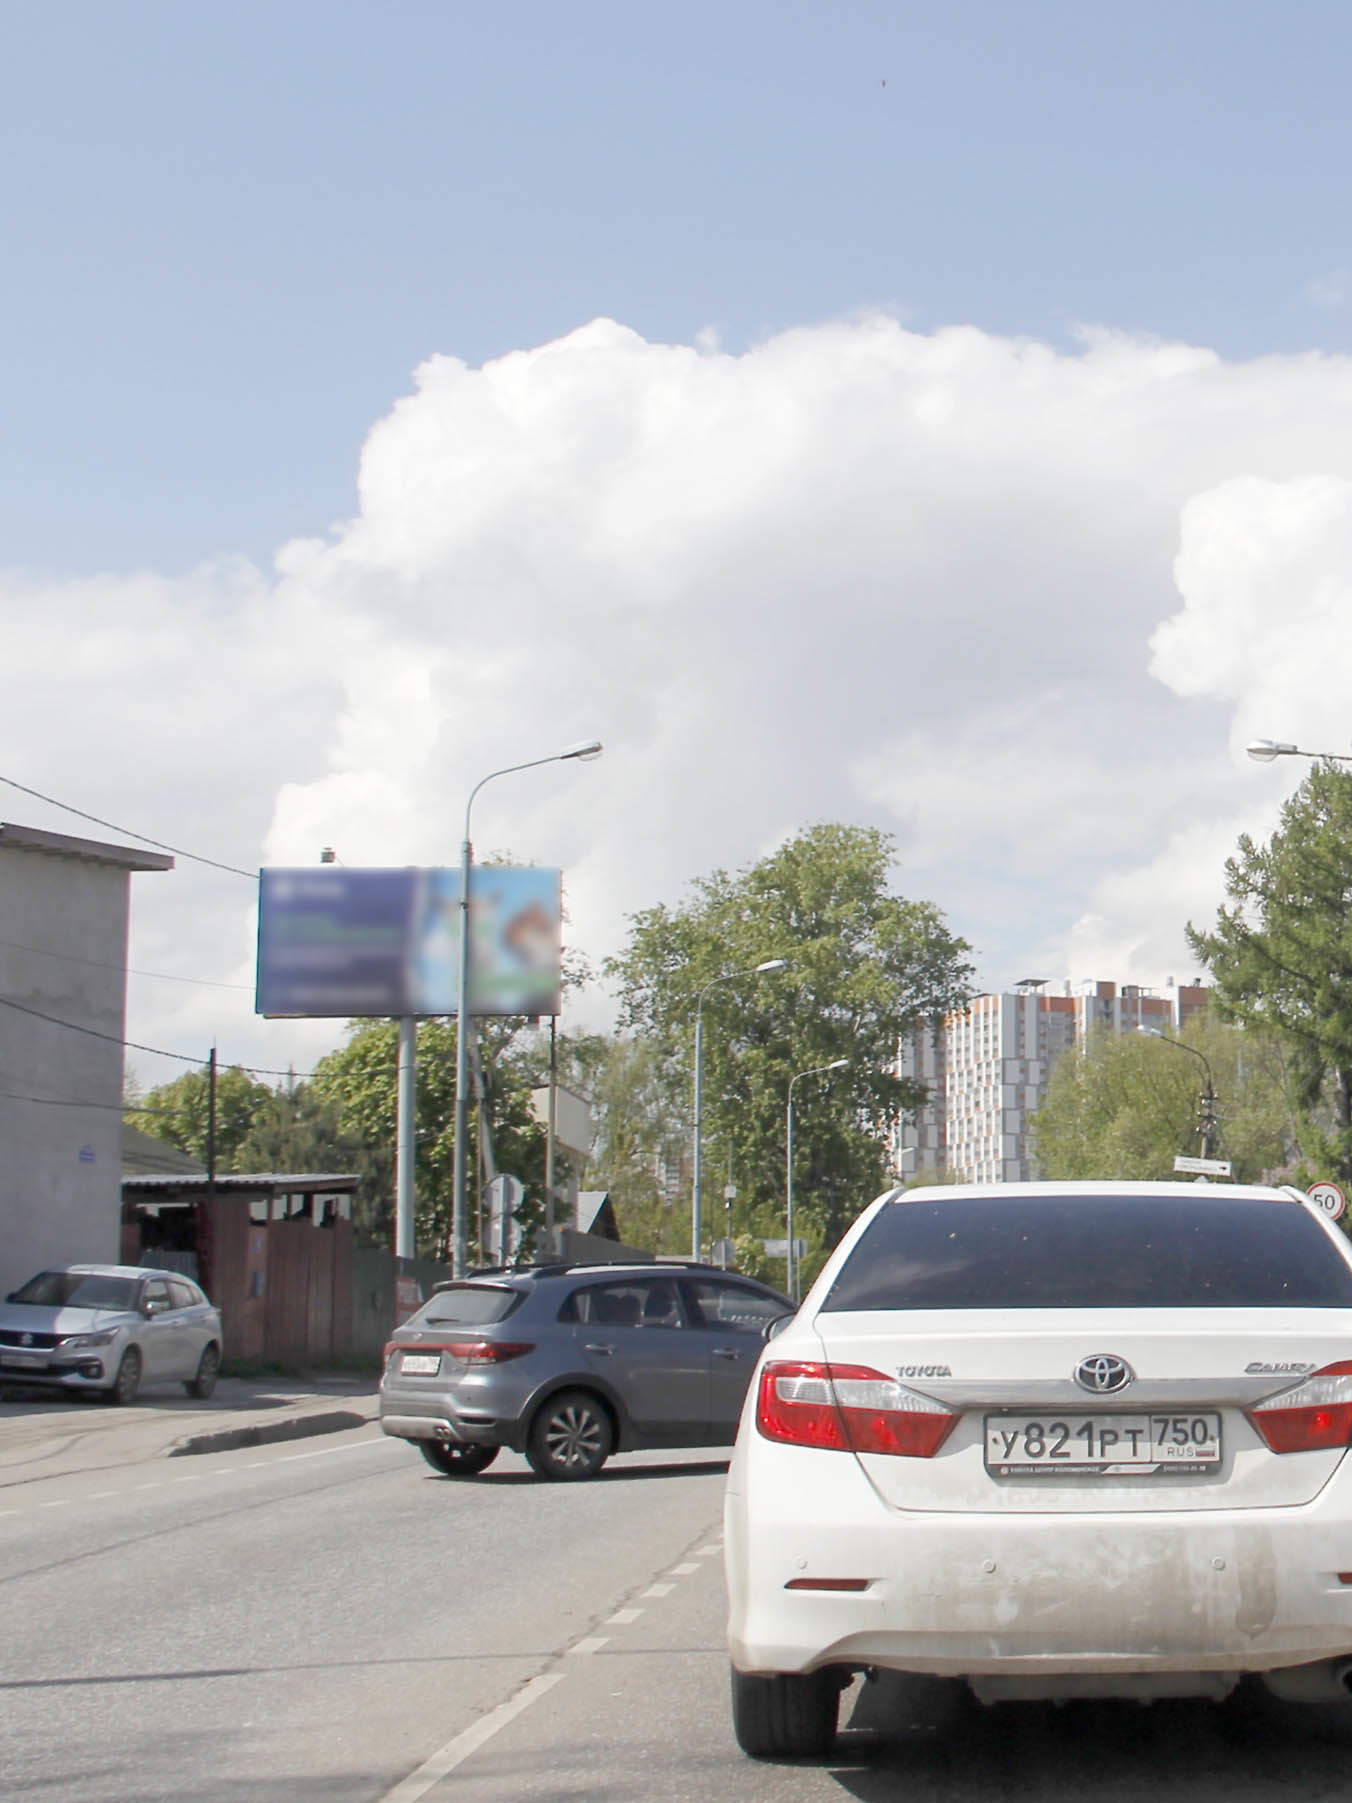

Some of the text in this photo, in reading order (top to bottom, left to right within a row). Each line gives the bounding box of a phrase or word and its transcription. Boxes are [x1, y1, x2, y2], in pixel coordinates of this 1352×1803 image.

[1313, 1194, 1336, 1210] 50
[896, 1365, 952, 1377] TOYOTA
[1154, 1417, 1208, 1446] 750
[1167, 1446, 1194, 1457] RUS
